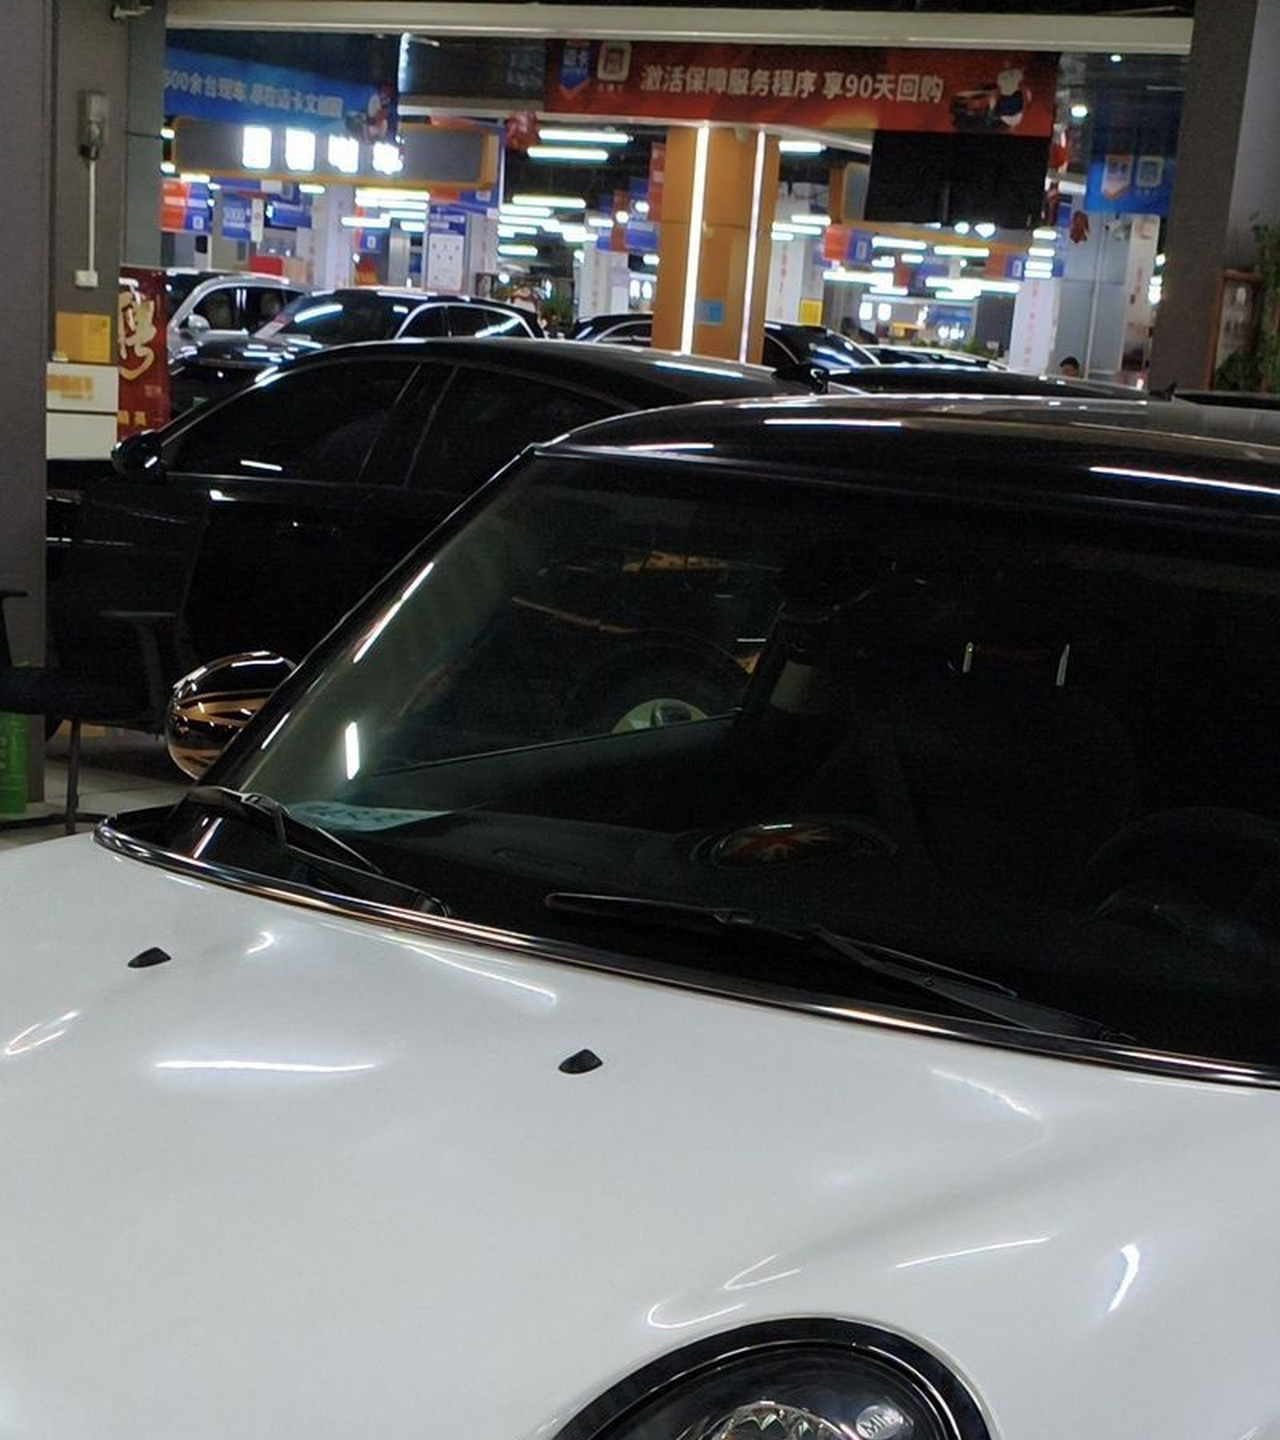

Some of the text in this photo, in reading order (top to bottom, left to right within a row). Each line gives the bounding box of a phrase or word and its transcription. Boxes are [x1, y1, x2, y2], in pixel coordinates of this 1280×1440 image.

[640, 64, 944, 103] 激活保障服务程序 享90天回购
